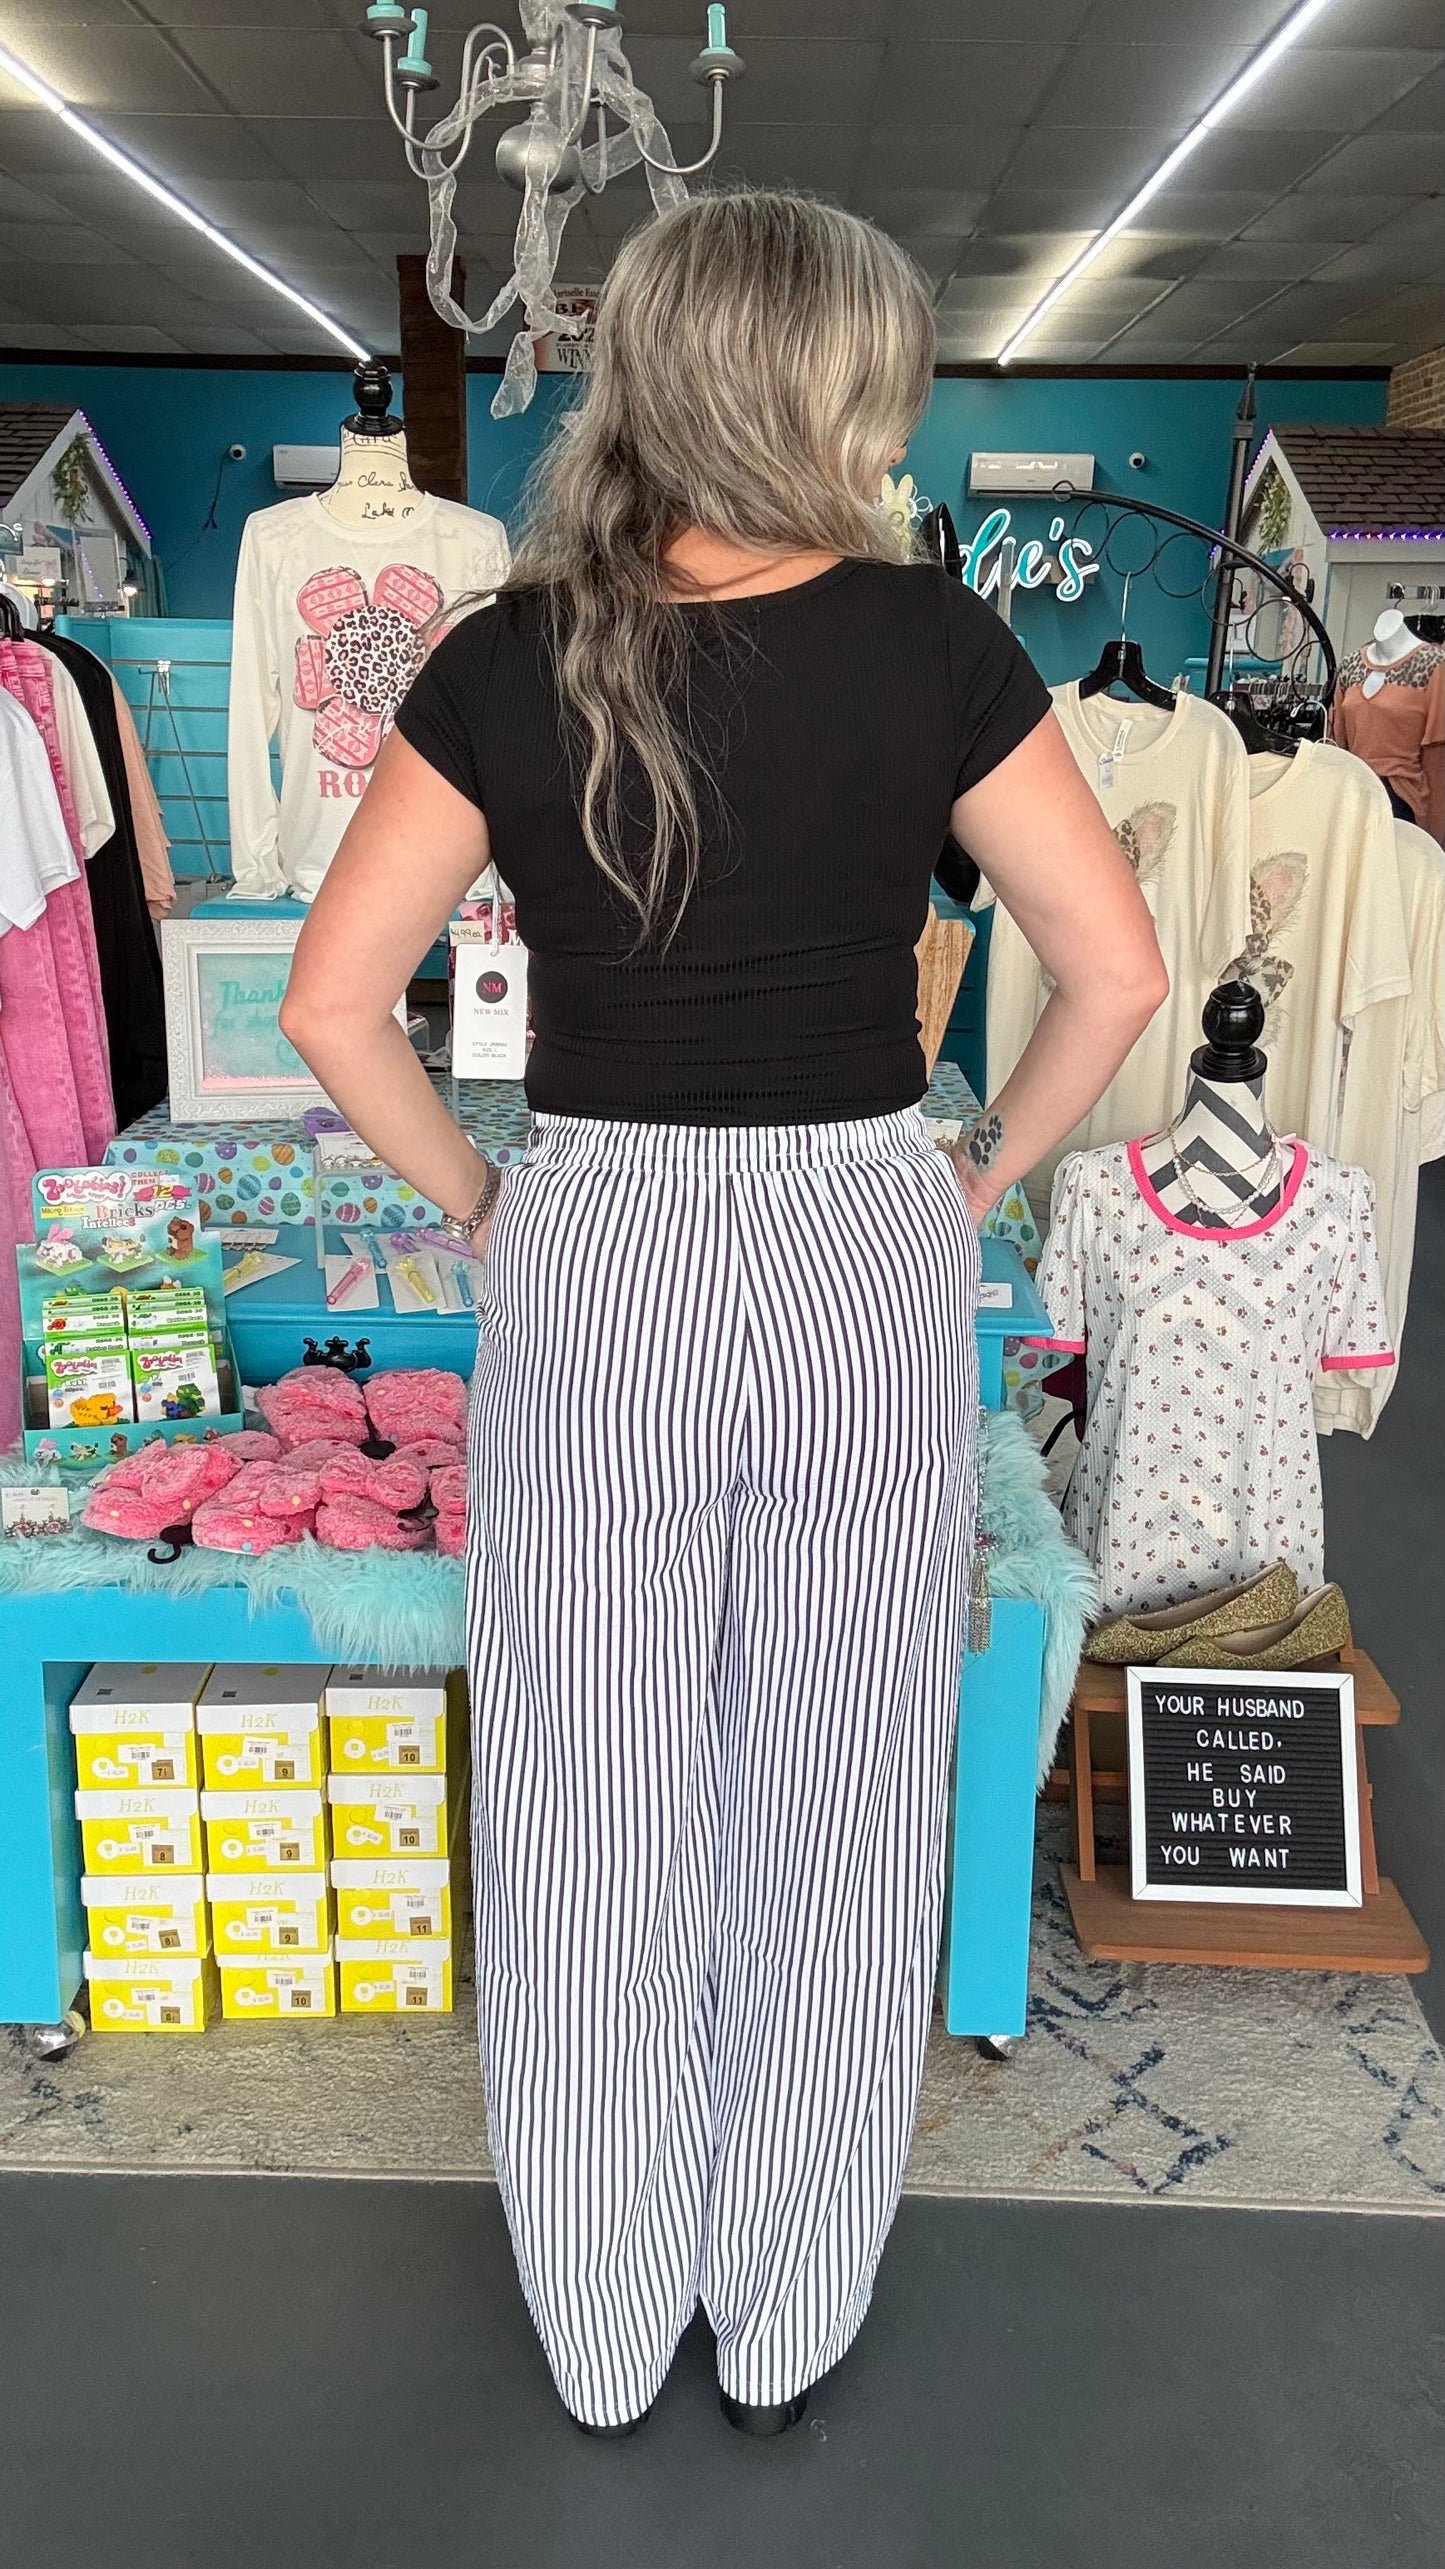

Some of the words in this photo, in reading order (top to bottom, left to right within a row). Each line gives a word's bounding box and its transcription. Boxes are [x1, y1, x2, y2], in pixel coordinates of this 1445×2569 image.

[959, 508, 1100, 602] lie's
[482, 981, 503, 993] NM
[473, 1007, 491, 1015] NEW
[493, 1008, 509, 1016] MIX
[95, 1203, 155, 1219] Bricks
[367, 1695, 404, 1710] H2K
[1155, 1694, 1205, 1716] YOUR
[1217, 1697, 1305, 1718] HUSBAND
[114, 1708, 151, 1724] H2K
[241, 1712, 278, 1728] H2K
[403, 1753, 416, 1762] 10
[281, 1768, 289, 1777] 9
[1187, 1762, 1213, 1782] HE
[1240, 1764, 1286, 1784] SAID
[369, 1783, 405, 1798] H2K
[1212, 1788, 1257, 1808] BUY
[119, 1798, 155, 1813] H2K
[244, 1799, 280, 1813] H2K
[1171, 1812, 1292, 1835] WHATEVER
[403, 1835, 415, 1844] 10
[159, 1852, 166, 1861] 8
[285, 1849, 293, 1858] 9
[1160, 1845, 1200, 1865] YOU
[1229, 1847, 1290, 1868] WANT
[373, 1869, 409, 1884] H2K
[124, 1885, 160, 1901] H2K
[249, 1881, 285, 1895] H2K
[416, 1925, 427, 1933] 11
[284, 1934, 291, 1943] 9
[294, 1997, 307, 2006] 10
[412, 1996, 423, 2004] 11
